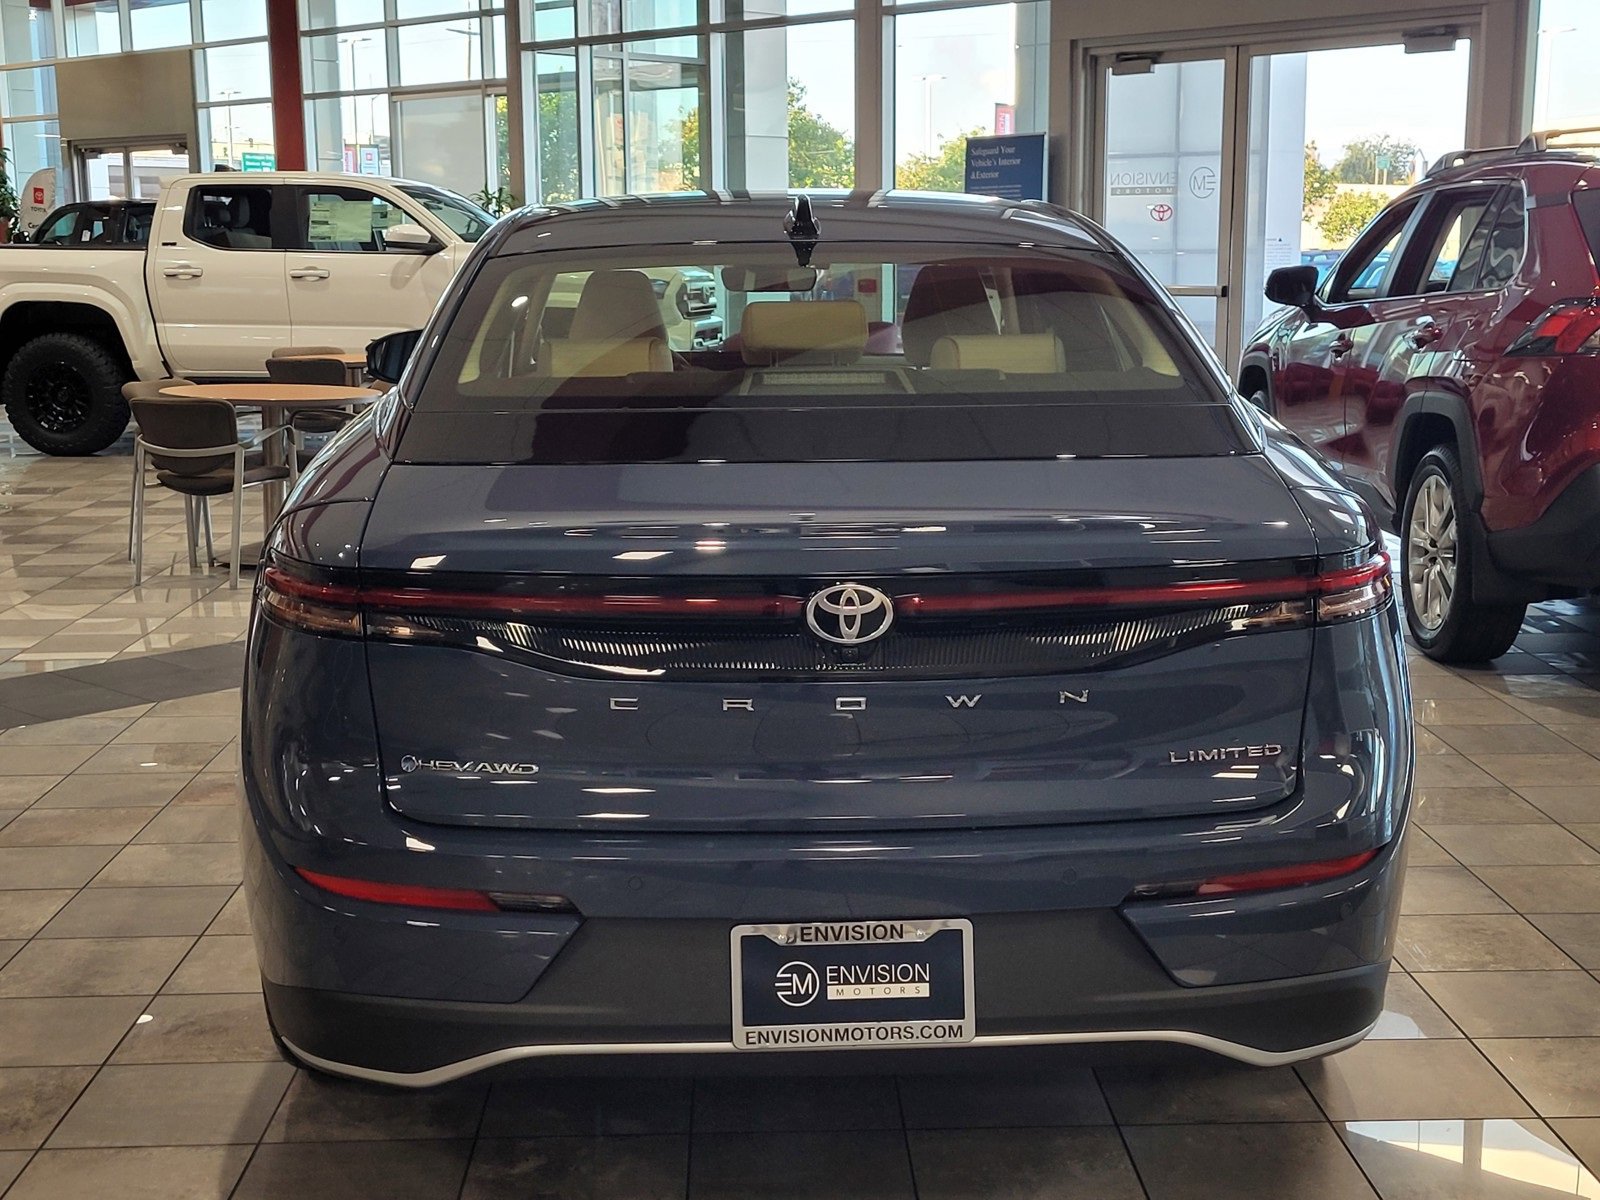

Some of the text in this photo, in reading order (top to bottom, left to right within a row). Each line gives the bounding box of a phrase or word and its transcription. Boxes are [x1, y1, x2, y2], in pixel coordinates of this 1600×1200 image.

[971, 145, 1016, 157] Safeguard Your
[971, 157, 1021, 167] Vehicle's Interior
[610, 689, 1089, 712] CROWN
[1169, 744, 1282, 763] LIMITED
[474, 761, 540, 775] AWD
[800, 923, 904, 943] ENVISION
[826, 963, 930, 985] ENVISION
[836, 985, 921, 997] MOTORS
[745, 1024, 964, 1046] ENVISIONMOTORS.COM
